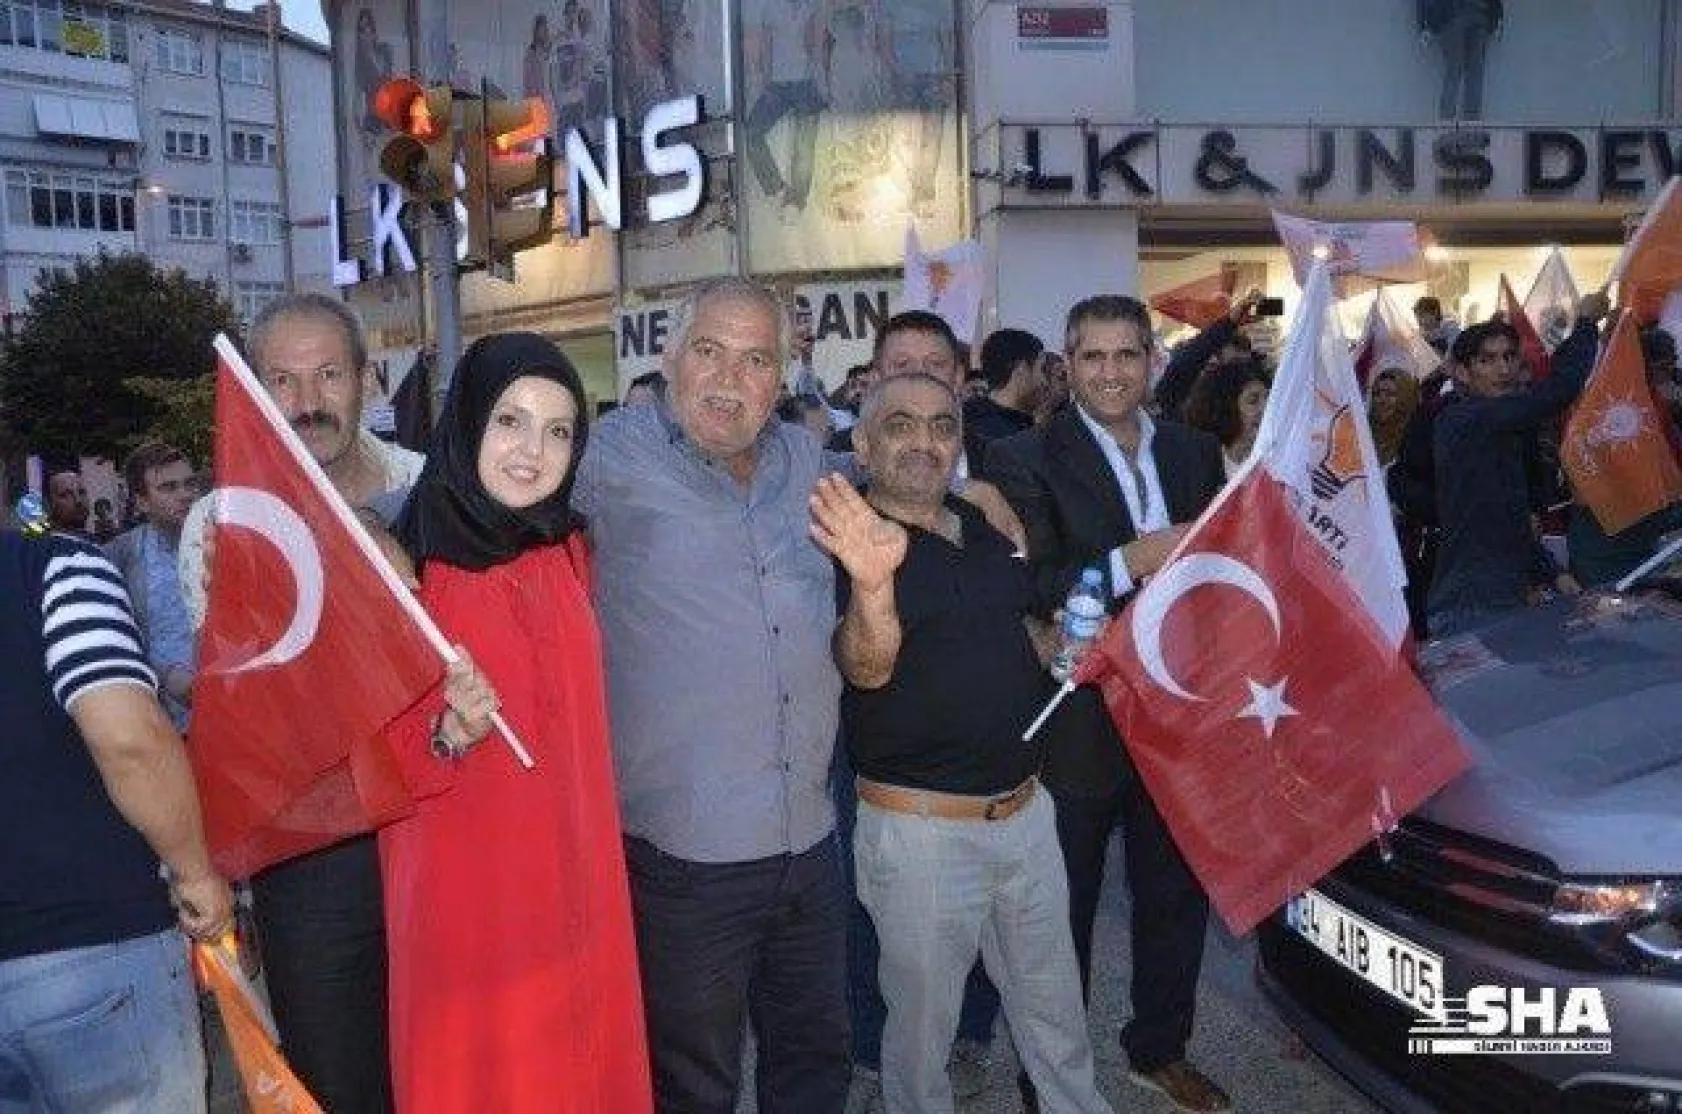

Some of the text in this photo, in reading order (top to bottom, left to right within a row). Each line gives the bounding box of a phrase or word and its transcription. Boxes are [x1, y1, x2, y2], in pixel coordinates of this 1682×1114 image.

[1026, 129, 1156, 195] LK
[1196, 131, 1278, 194] &
[1300, 130, 1494, 196] JNS
[330, 181, 416, 286] LK
[1387, 945, 1436, 1010] 105
